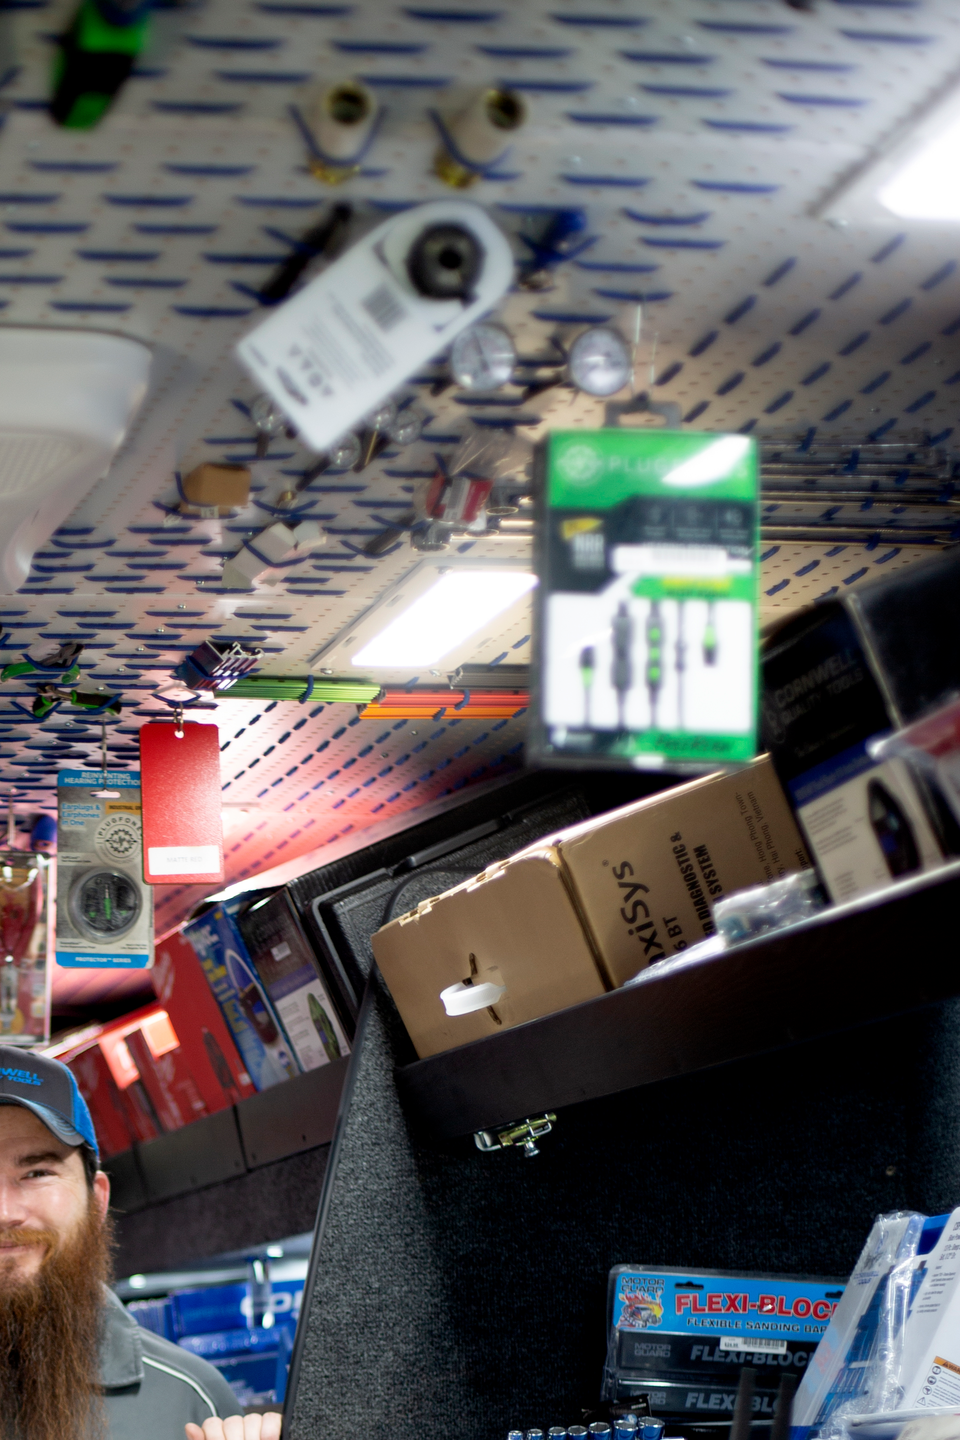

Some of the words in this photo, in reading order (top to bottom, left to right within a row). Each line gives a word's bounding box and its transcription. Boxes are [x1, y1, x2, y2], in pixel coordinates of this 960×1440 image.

[64, 777, 97, 785] HEARING
[62, 803, 94, 812] Earplugs
[746, 791, 764, 822] Vietnam
[62, 811, 100, 819] Earphones
[743, 815, 760, 841] Phong
[670, 831, 682, 843] &
[753, 841, 768, 863] Hong
[769, 850, 780, 864] Hai
[166, 855, 189, 864] MATTE
[190, 855, 203, 863] RED
[693, 844, 723, 896] SYSTEM
[672, 843, 711, 921] DIAGNOSTIC
[7, 1075, 41, 1086] TOOLS
[621, 1276, 665, 1286] MOTOR
[621, 1285, 664, 1294] GUARD
[675, 1292, 839, 1321] FLEXI-BLOC
[687, 1317, 741, 1330] FLEXIBLE
[746, 1320, 800, 1333] SANDING
[634, 1342, 671, 1351] MOTOR
[634, 1350, 671, 1358] GUARD
[690, 1345, 810, 1367] FLEXI-BLOC
